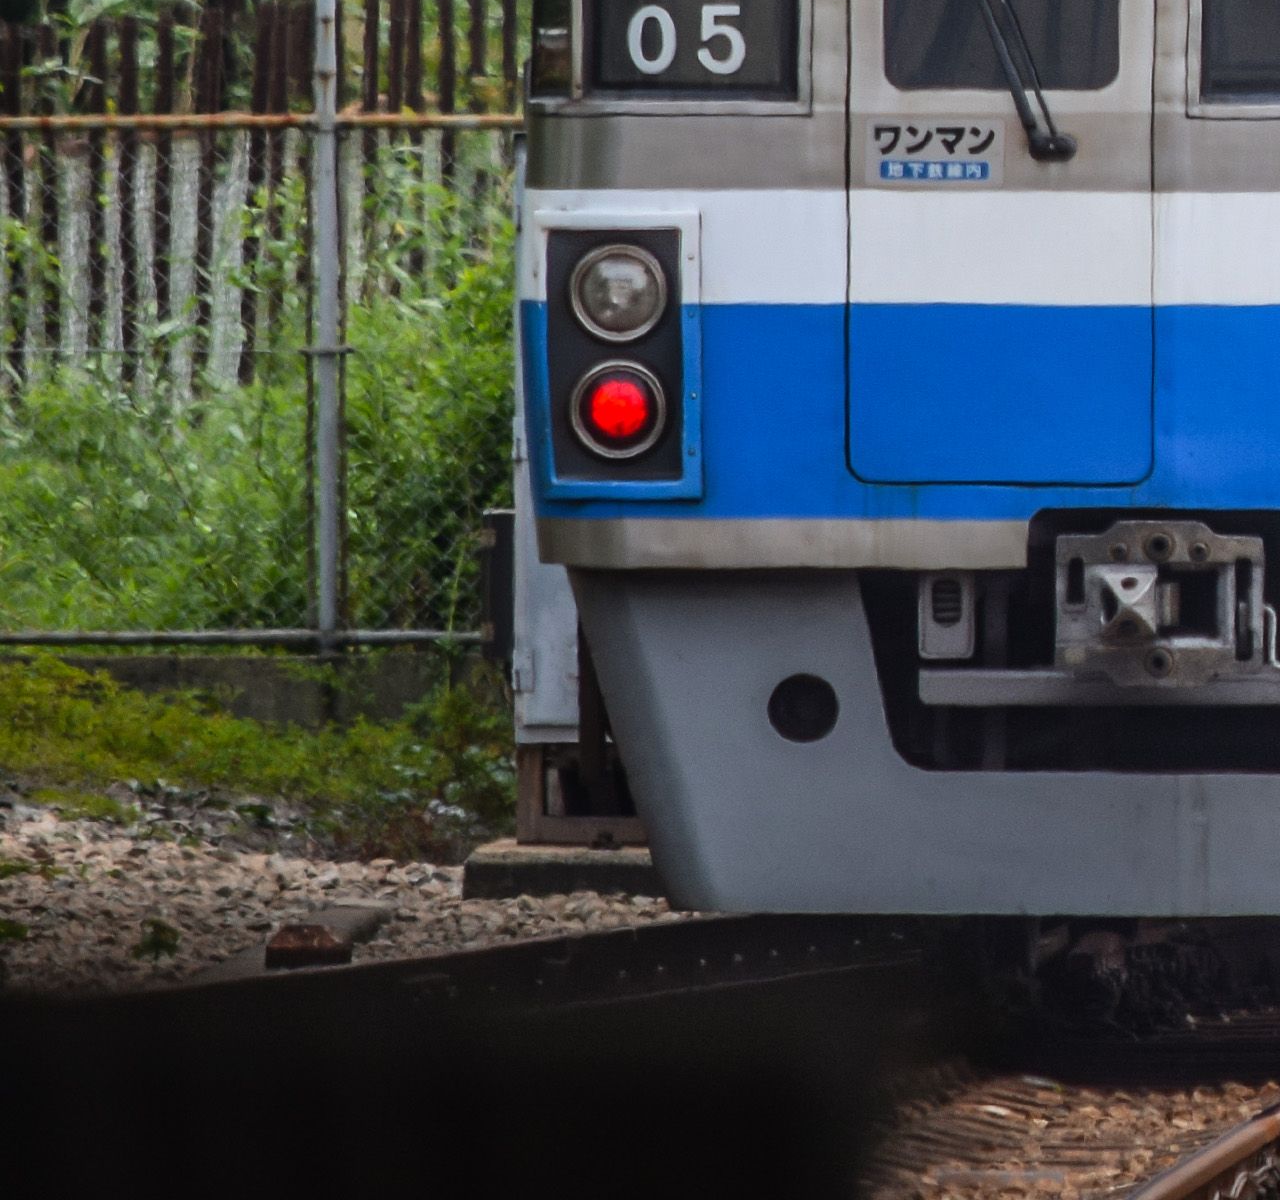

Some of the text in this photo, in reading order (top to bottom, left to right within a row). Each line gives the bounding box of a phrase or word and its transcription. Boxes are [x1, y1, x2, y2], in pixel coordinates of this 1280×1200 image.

[627, 4, 746, 75] 05
[874, 126, 995, 155] ワンマン
